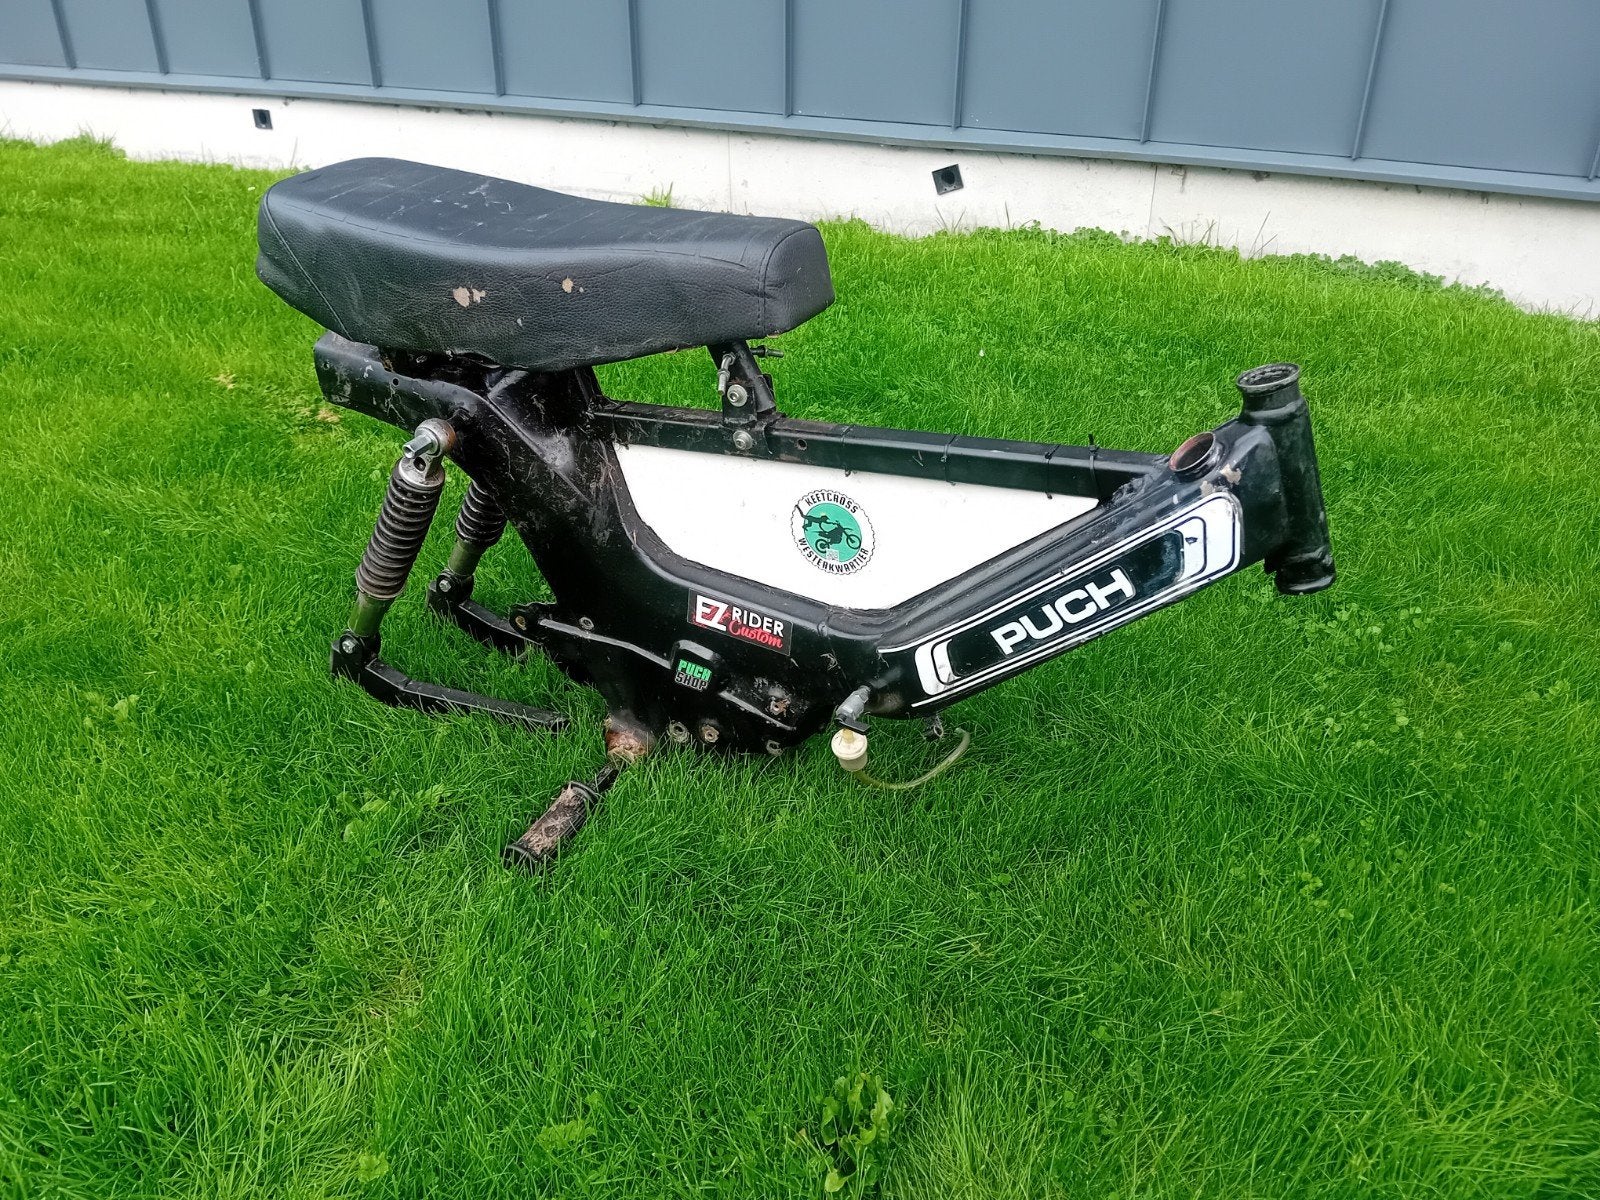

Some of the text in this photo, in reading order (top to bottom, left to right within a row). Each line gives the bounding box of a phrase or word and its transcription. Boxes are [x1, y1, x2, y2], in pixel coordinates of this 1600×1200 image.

[804, 493, 858, 513] KEETCROSS
[799, 538, 869, 572] WESTERKWARTIER
[695, 594, 784, 637] EZ RIDER
[990, 568, 1134, 655] PUCH
[728, 620, 783, 648] Custom
[674, 671, 709, 692] SHOP
[677, 659, 712, 682] PUCH
